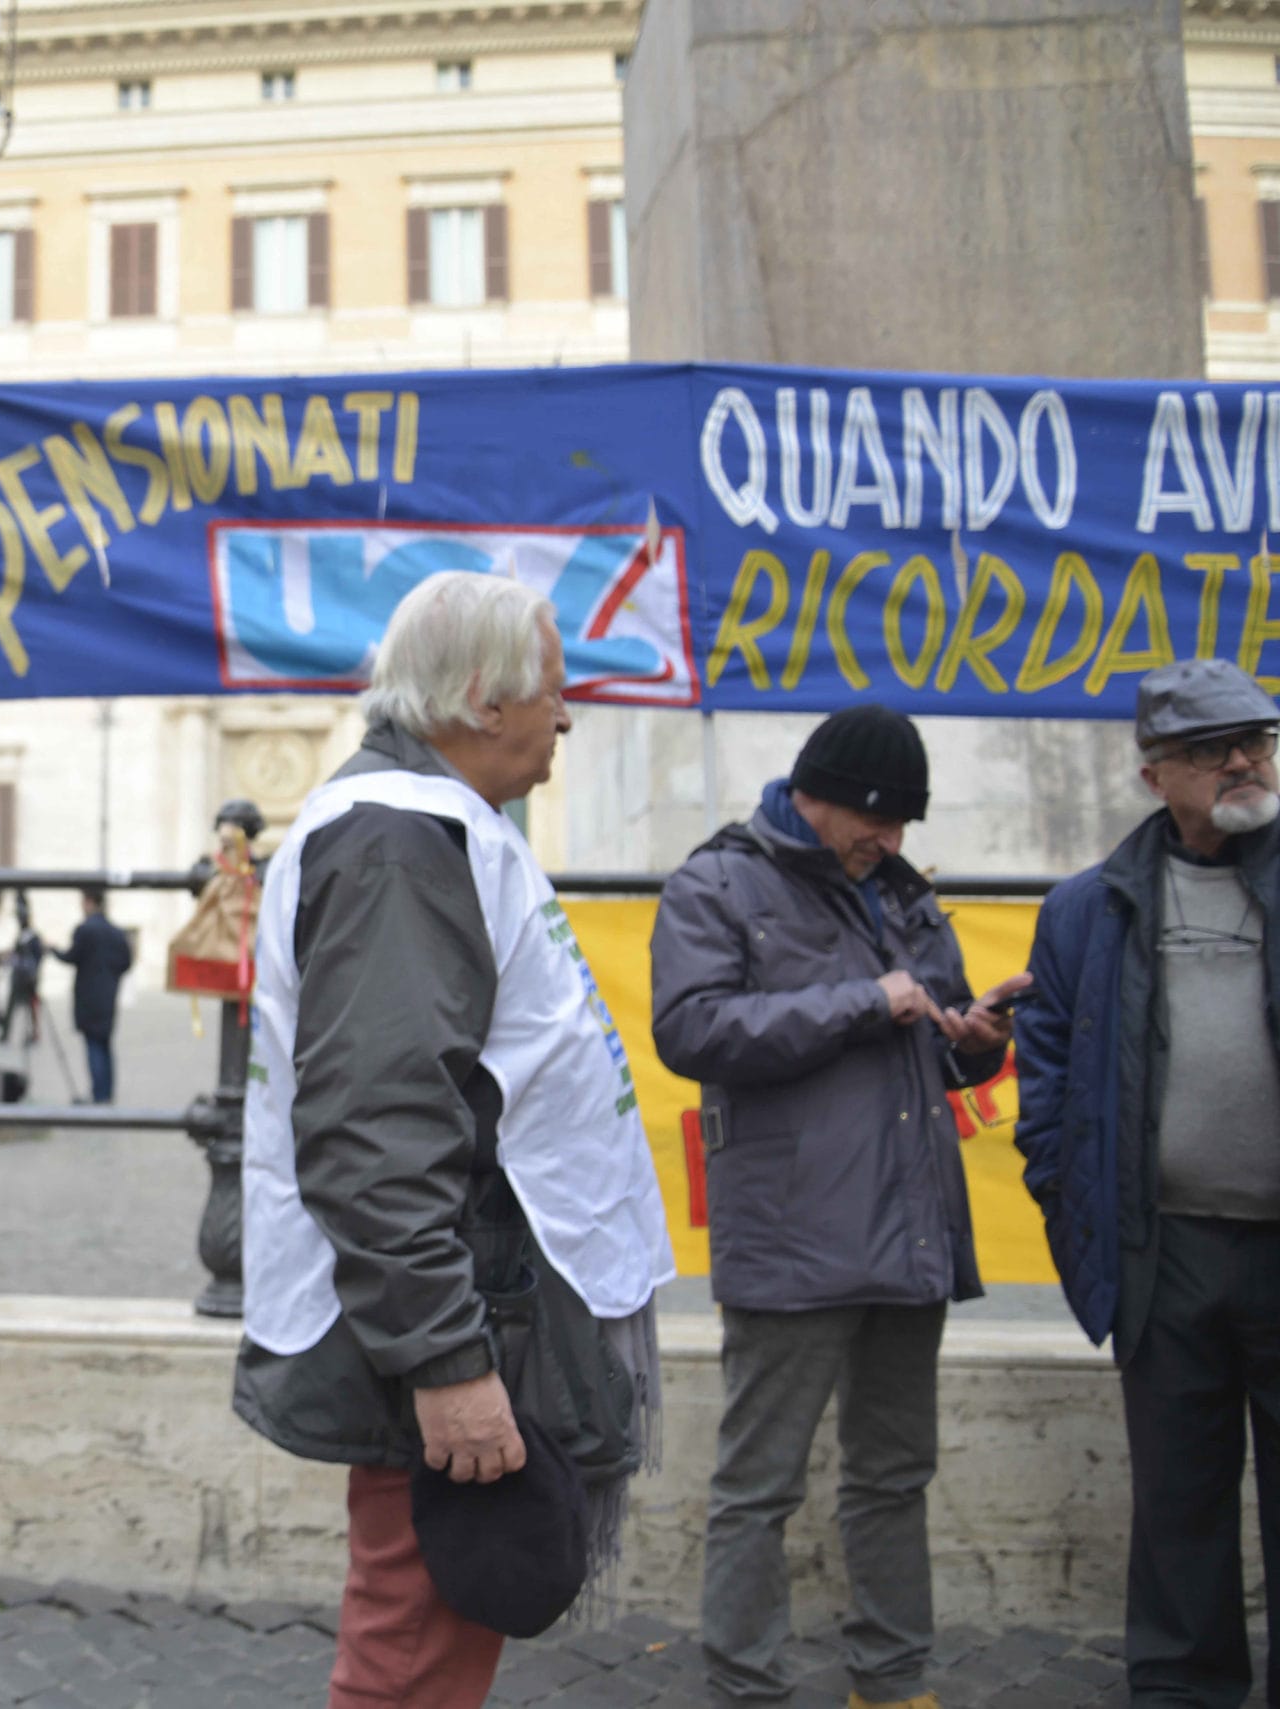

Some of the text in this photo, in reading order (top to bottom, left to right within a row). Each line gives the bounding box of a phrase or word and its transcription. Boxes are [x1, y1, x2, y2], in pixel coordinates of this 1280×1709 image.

[700, 387, 1280, 535] QUANDO AV
[705, 549, 1280, 697] RICORDATE
